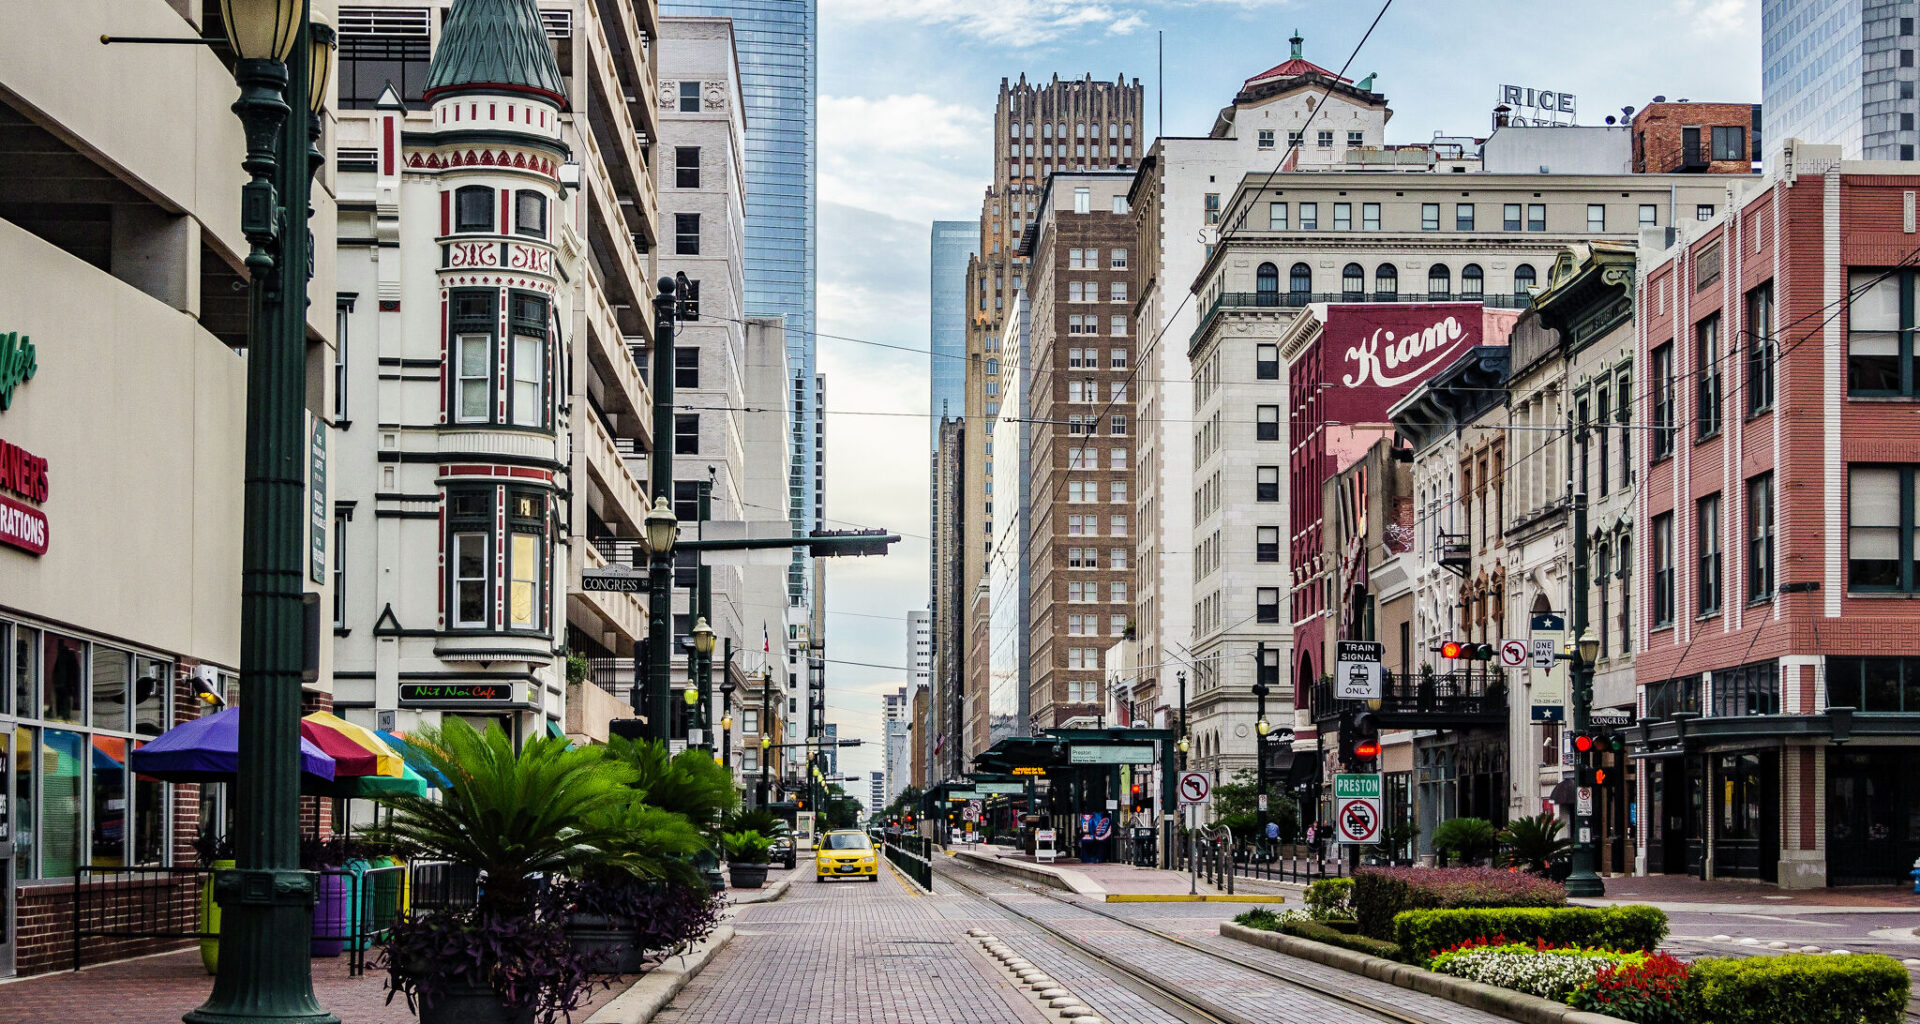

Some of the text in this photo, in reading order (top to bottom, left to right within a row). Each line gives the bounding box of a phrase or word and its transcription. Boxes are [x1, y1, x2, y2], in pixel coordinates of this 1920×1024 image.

[1504, 85, 1574, 113] RICE
[1342, 316, 1469, 388] Kiam
[0, 503, 45, 547] RATIONS
[583, 578, 638, 590] CONGRESS
[1345, 643, 1375, 652] TRAIN
[1341, 653, 1378, 662] SIGNAL
[415, 686, 496, 699] Nit Noi Cafe
[1345, 687, 1372, 695] ONLY
[382, 715, 391, 725] NO
[1592, 716, 1628, 725] CONGRESS
[1338, 779, 1378, 792] PRESTON
